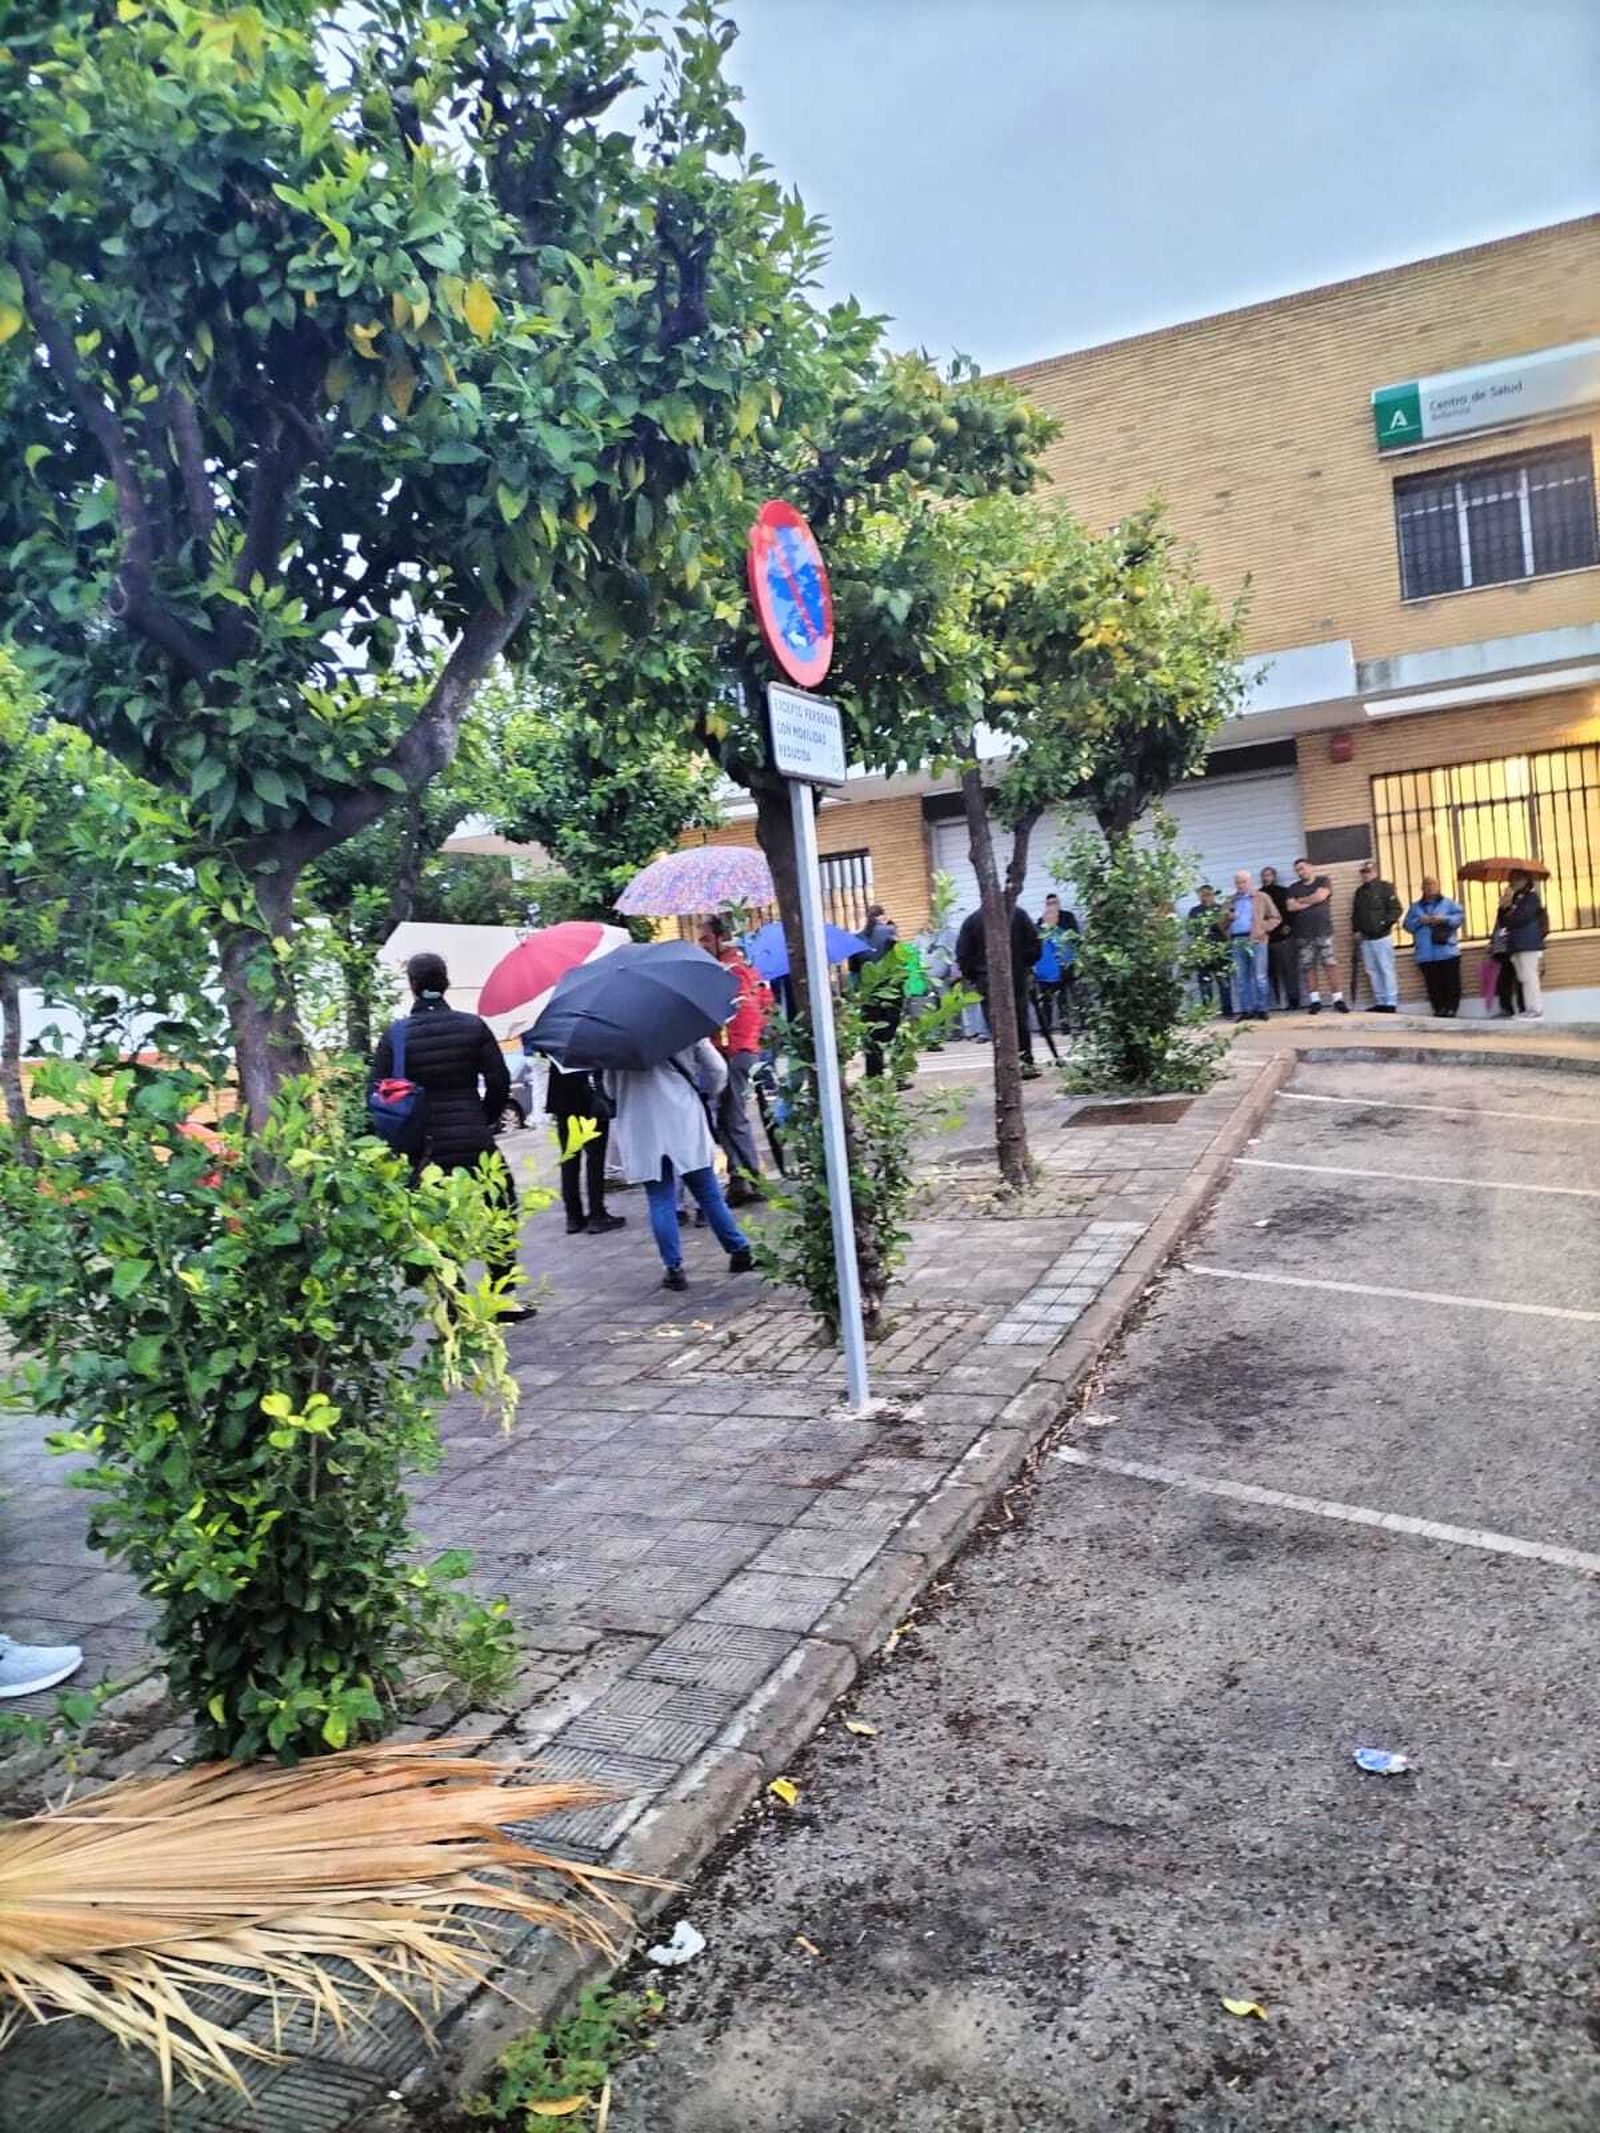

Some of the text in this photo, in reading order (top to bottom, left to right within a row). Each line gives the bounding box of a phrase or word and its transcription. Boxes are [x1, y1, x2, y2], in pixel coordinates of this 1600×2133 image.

[1429, 379, 1523, 411] Centro de Salud
[804, 707, 838, 728] PERSONAS
[777, 720, 827, 746] CON MOVILIDAD
[778, 743, 812, 762] REDUCIDA
